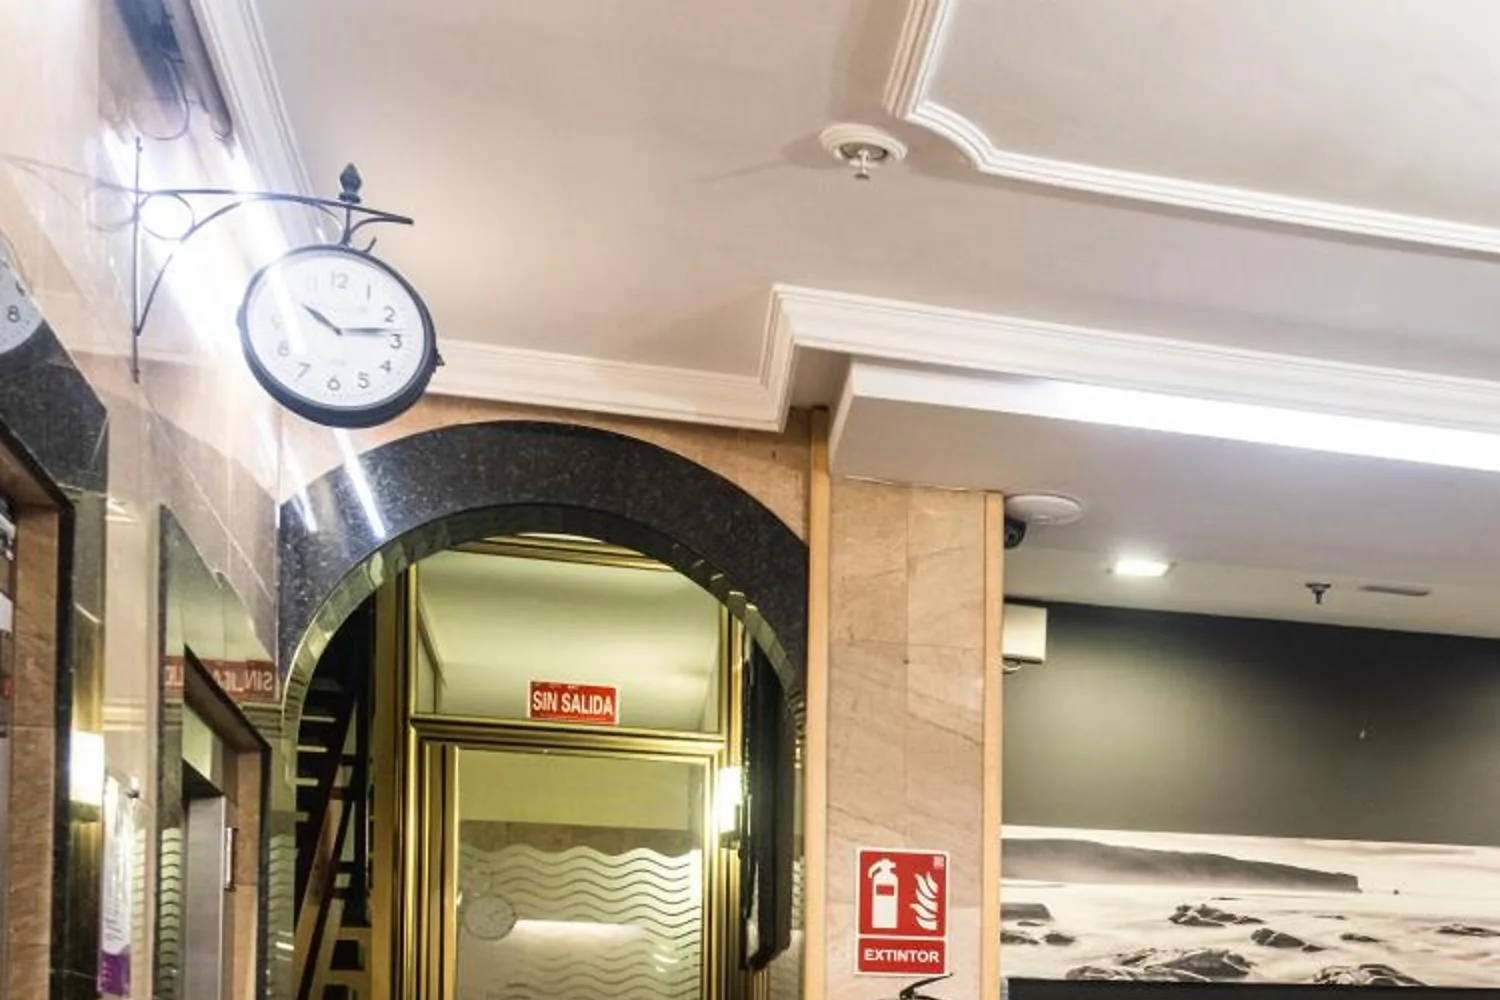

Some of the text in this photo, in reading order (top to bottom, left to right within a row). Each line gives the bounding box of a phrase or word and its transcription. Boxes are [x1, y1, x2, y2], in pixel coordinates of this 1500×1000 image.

[331, 270, 348, 289] 12
[383, 305, 396, 323] 2
[277, 340, 290, 357] 8
[390, 333, 402, 350] 3
[298, 363, 311, 379] 7
[379, 359, 391, 373] 4
[326, 375, 341, 391] 6
[357, 372, 370, 389] 5
[533, 690, 613, 716] SIN SALIDA
[864, 948, 940, 963] EXTINTOR
